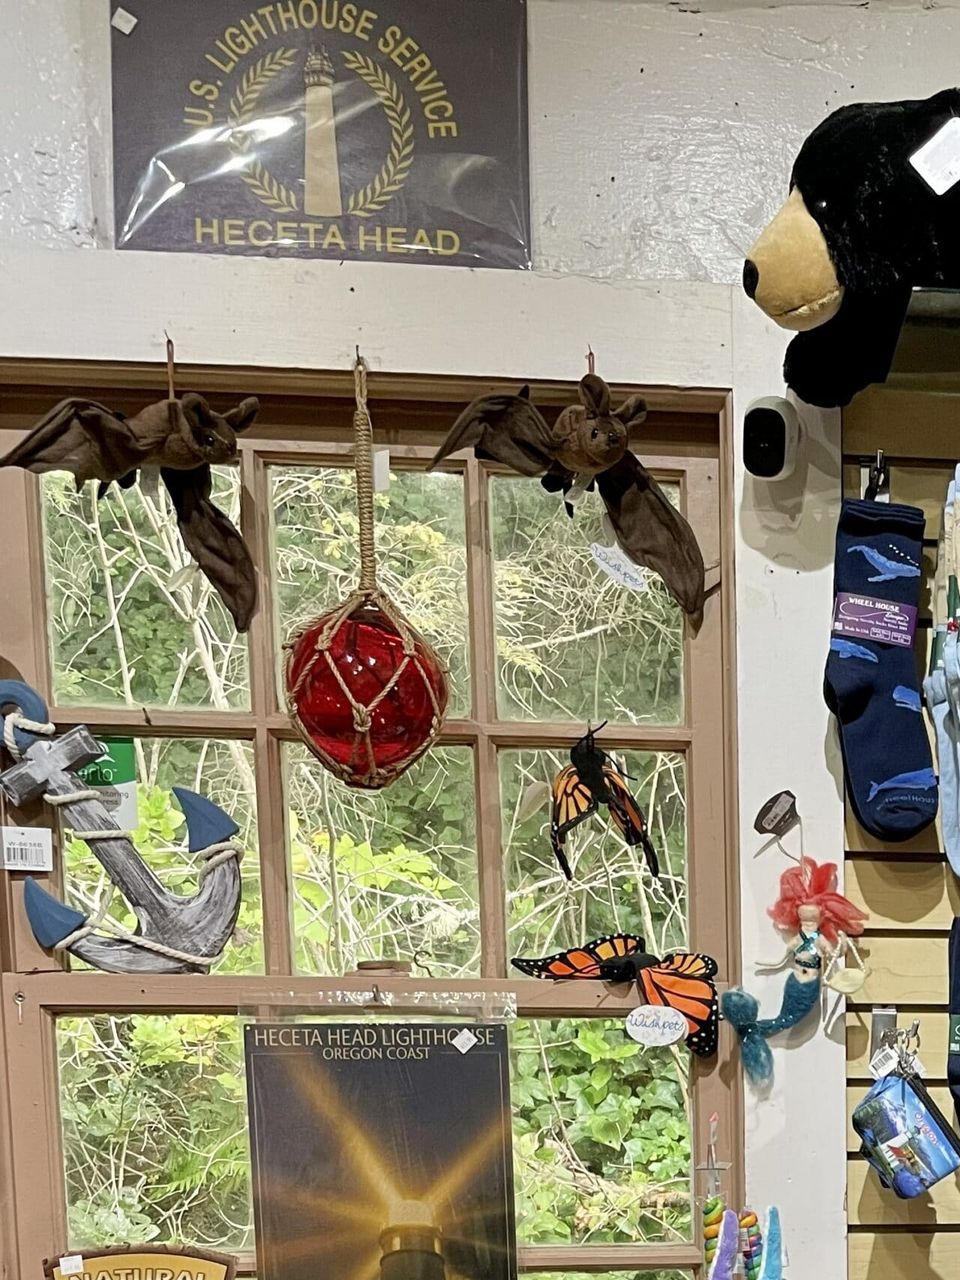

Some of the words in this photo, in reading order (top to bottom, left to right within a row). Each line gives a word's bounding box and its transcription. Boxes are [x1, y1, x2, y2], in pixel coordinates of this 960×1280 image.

[205, 0, 378, 74] LIGHTHOUSE
[378, 25, 459, 139] SERVICE
[194, 218, 346, 251] HECETA
[358, 223, 461, 257] HEAD
[849, 597, 874, 607] WHEEL
[875, 603, 900, 612] HOUSE
[254, 1029, 323, 1046] HECETA
[327, 1029, 377, 1046] HEAD
[322, 1048, 383, 1060] OREGON
[387, 1047, 430, 1060] COAST
